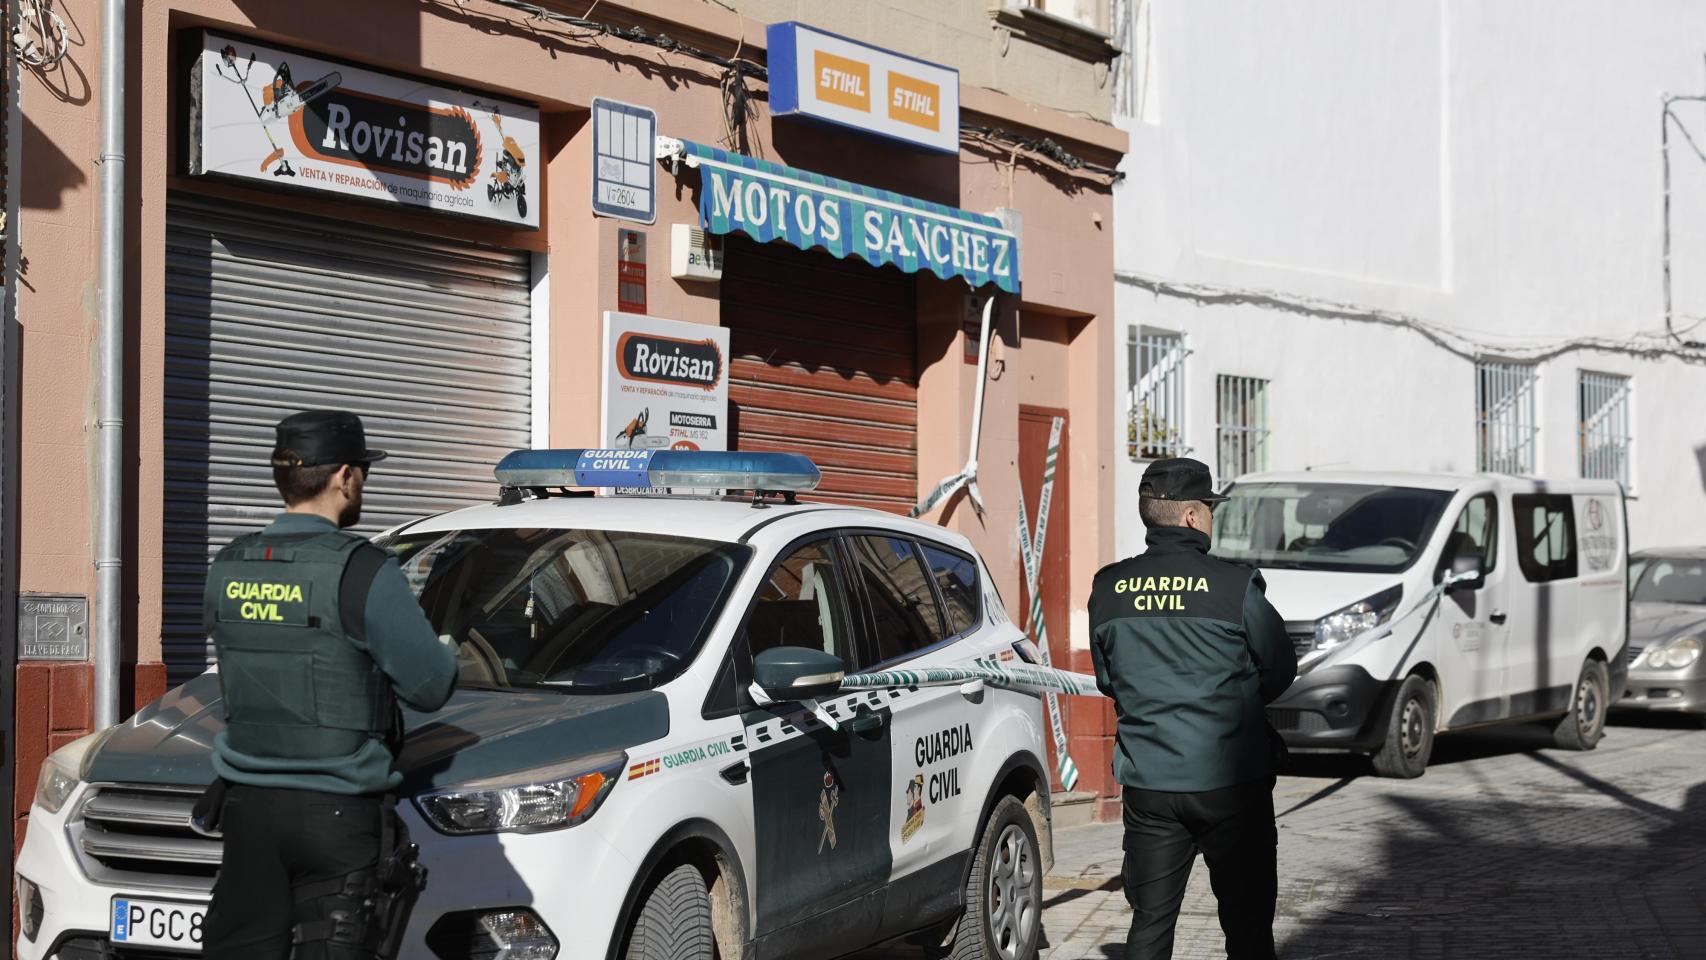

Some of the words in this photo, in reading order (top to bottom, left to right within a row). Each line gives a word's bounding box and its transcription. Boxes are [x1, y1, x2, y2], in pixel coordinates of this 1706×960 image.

[820, 67, 865, 97] STIHL
[893, 87, 935, 117] STIHL
[322, 103, 467, 174] Rovisan
[299, 167, 326, 180] VENTA
[328, 171, 334, 182] Y
[335, 173, 387, 192] REPARACIÓN
[387, 183, 398, 194] de
[400, 186, 443, 202] maquinaria
[711, 173, 840, 241] MOTOS
[863, 210, 1010, 276] SANCHEZ
[633, 343, 714, 381] Rovisan
[671, 414, 712, 428] MOTOSIERRA
[669, 428, 688, 438] STIHL
[584, 449, 648, 459] GUARDIA
[592, 459, 631, 470] CIVIL
[226, 581, 303, 603] GUARDIA
[1114, 576, 1209, 594] GUARDIA
[240, 601, 284, 621] CIVIL
[1134, 594, 1185, 611] CIVIL
[24, 644, 48, 655] LLAVE
[50, 644, 60, 655] DE
[663, 747, 707, 769] GUARDIA
[707, 741, 731, 757] CIVIL
[915, 723, 973, 768] GUARDIA
[929, 767, 961, 805] CIVIL
[117, 925, 125, 934] E
